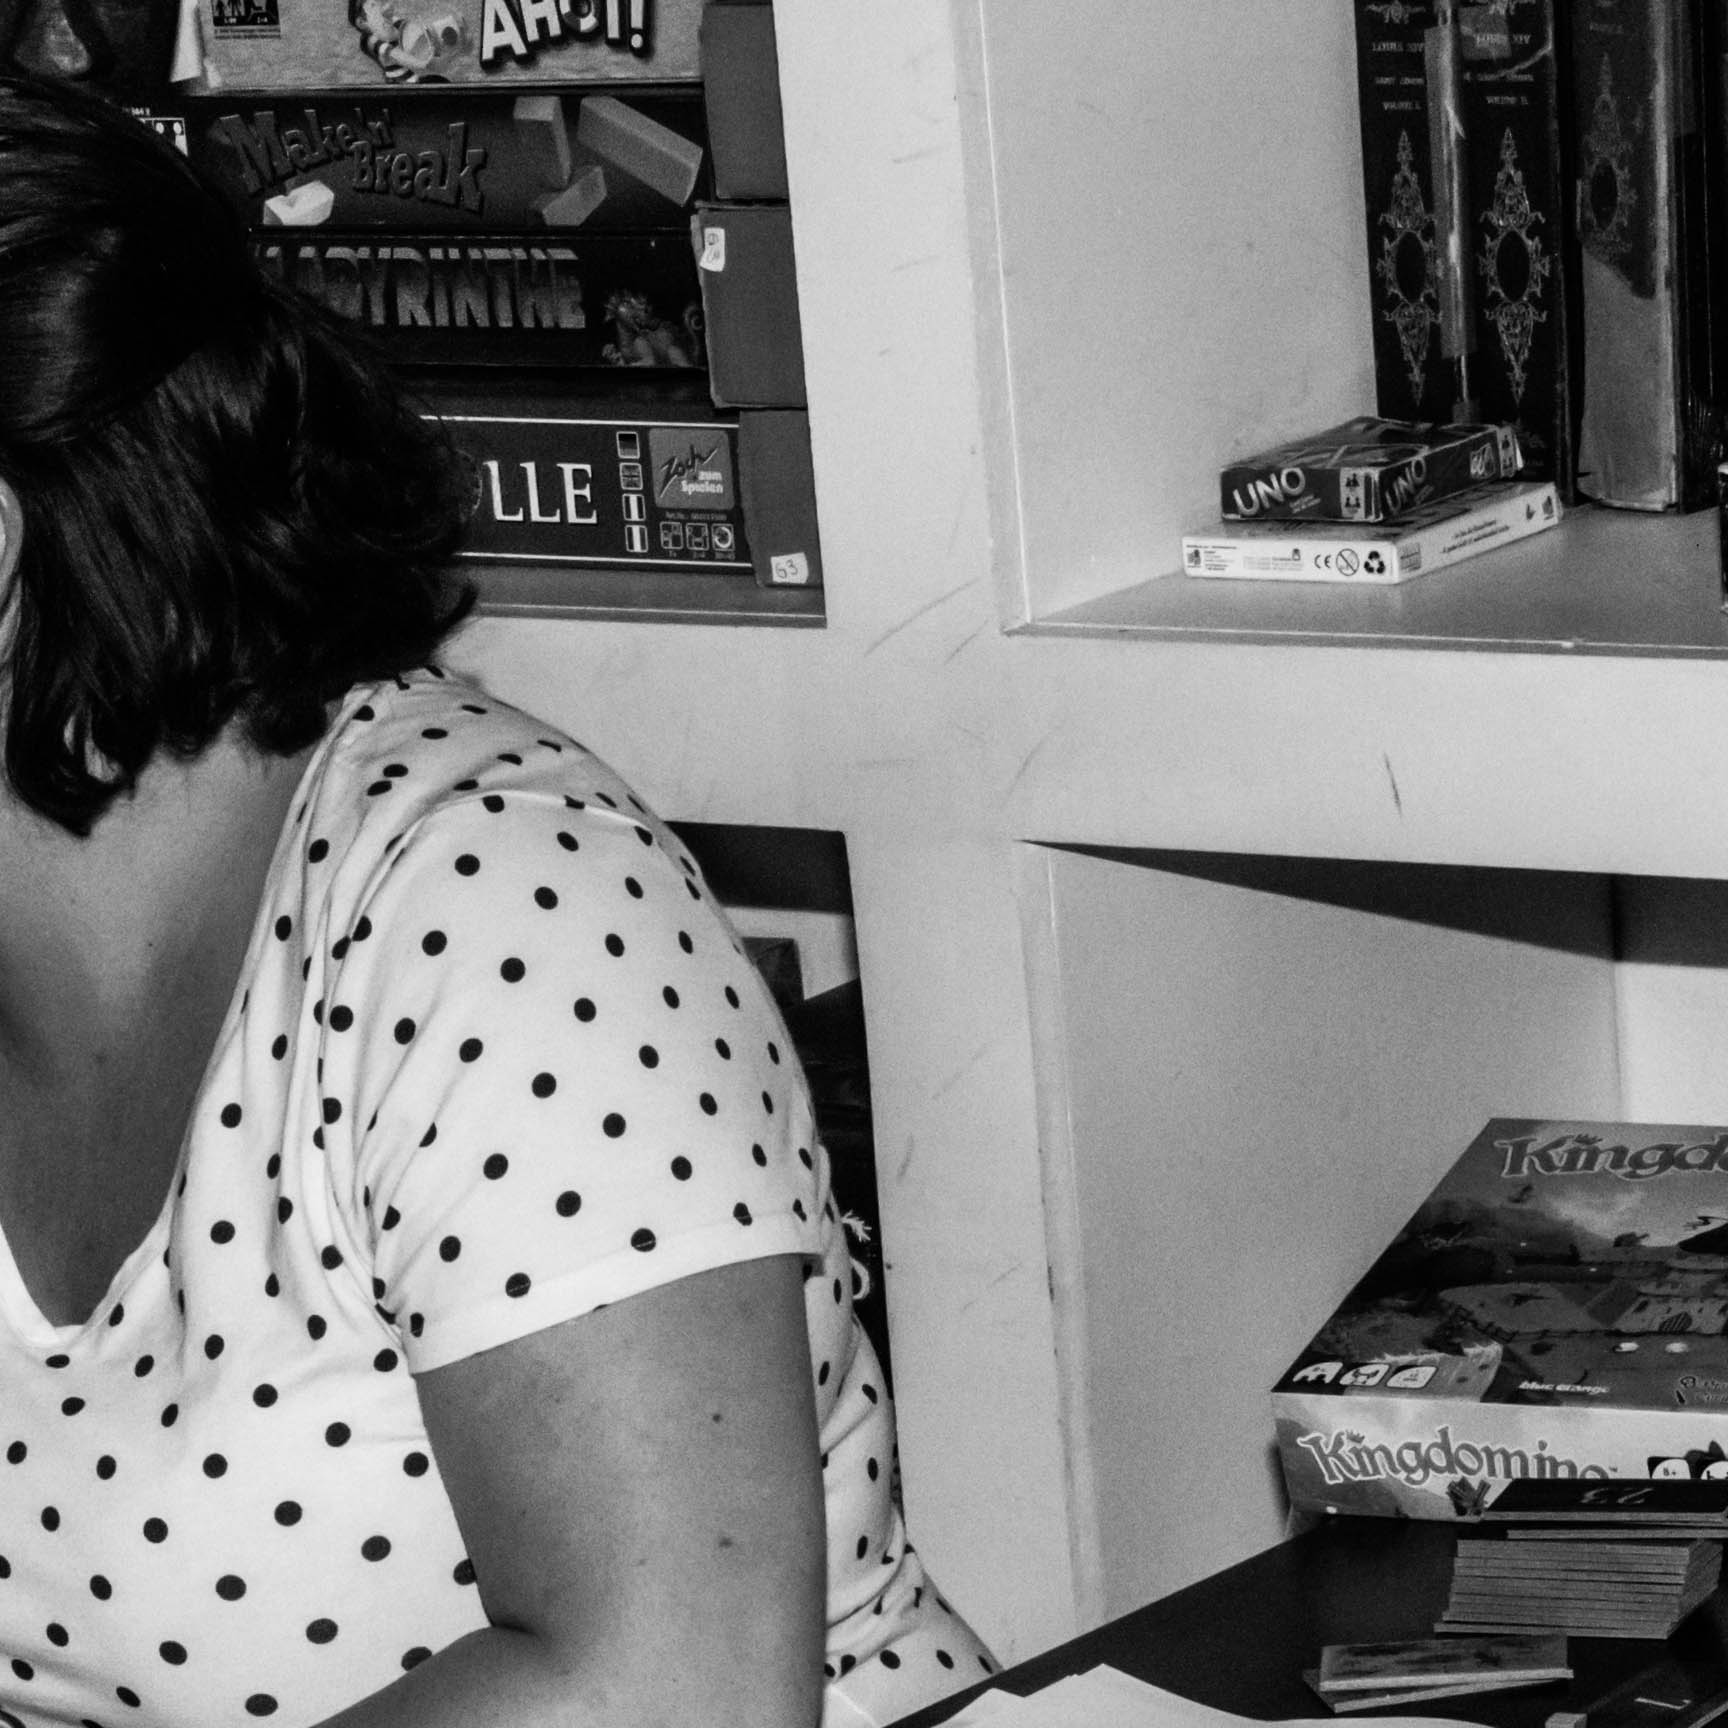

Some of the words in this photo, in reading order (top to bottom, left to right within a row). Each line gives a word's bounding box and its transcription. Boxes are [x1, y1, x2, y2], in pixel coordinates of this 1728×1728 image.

[1233, 467, 1306, 517] UNO
[1384, 456, 1428, 518] UNO
[1299, 1425, 1610, 1485] Kingdomino
